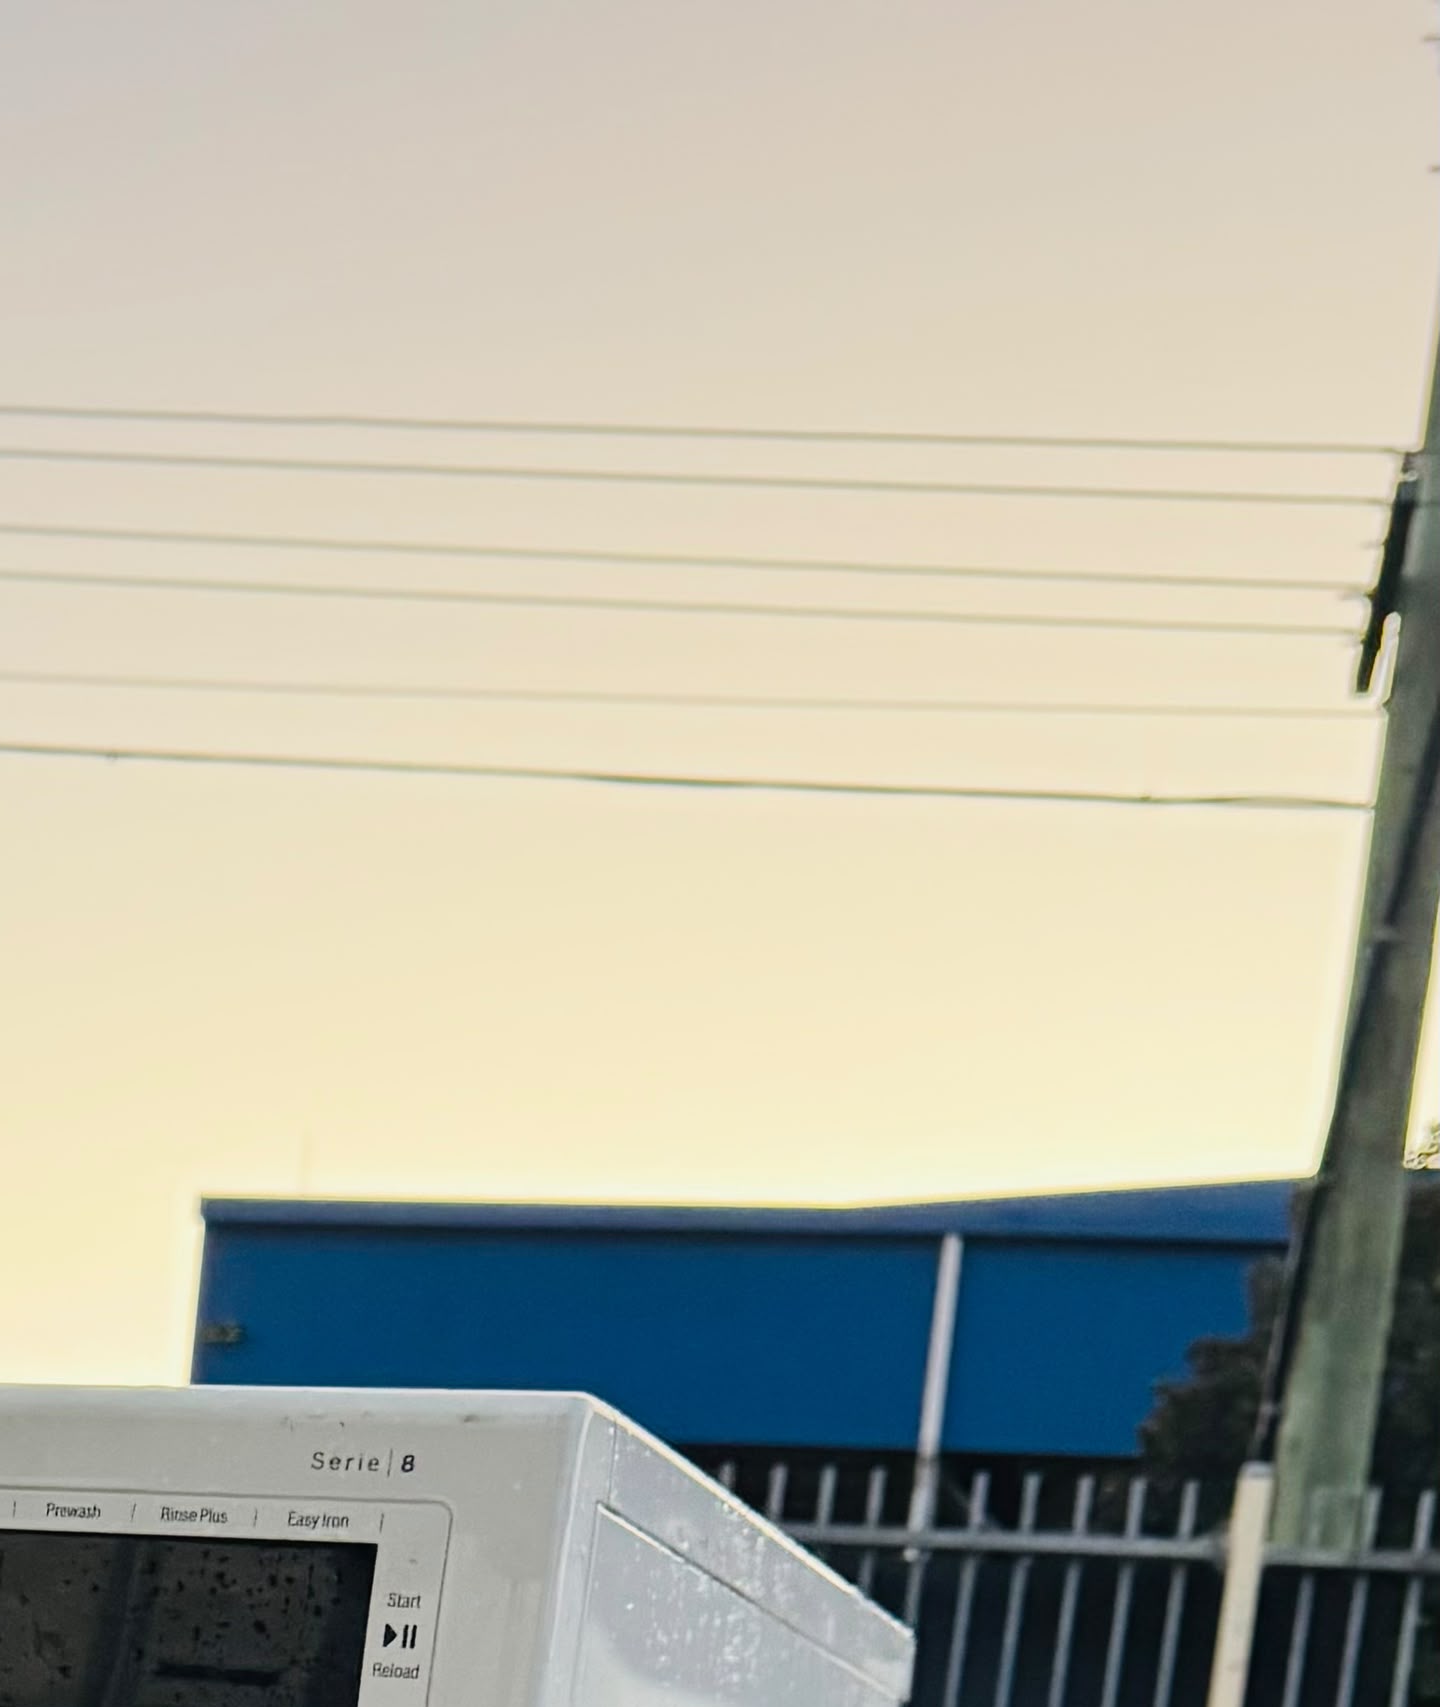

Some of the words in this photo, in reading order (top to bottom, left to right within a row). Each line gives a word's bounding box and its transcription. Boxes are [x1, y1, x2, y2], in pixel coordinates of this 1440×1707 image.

[310, 1451, 380, 1472] Serie
[401, 1454, 415, 1473] 8
[46, 1502, 101, 1519] Prewash
[161, 1506, 198, 1523] Rinse
[200, 1507, 228, 1524] Plus
[288, 1511, 319, 1530] Easy
[322, 1513, 349, 1528] Iron
[387, 1592, 421, 1608] Start
[372, 1662, 420, 1680] Reload
